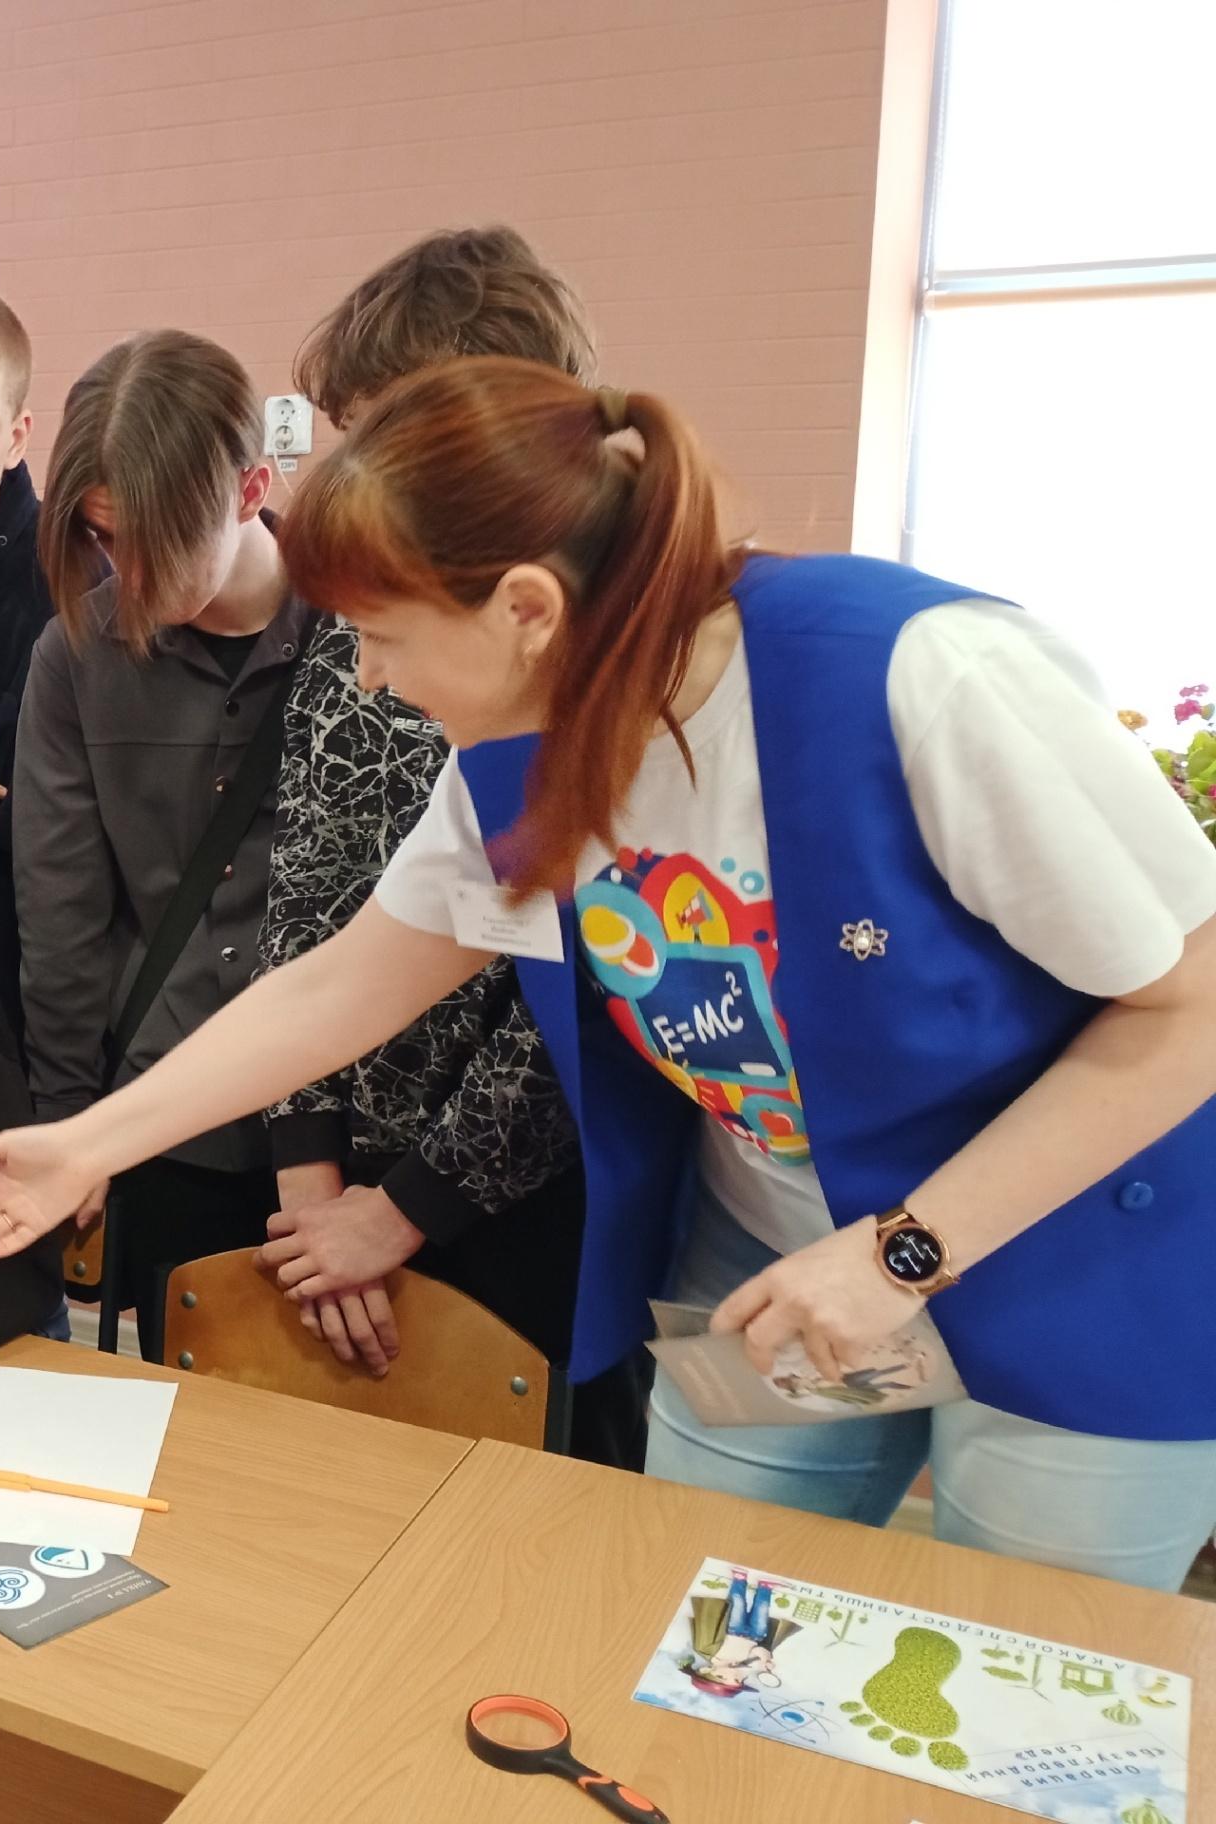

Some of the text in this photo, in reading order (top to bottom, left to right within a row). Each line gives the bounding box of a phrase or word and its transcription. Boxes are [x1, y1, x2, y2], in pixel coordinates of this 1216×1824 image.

[834, 1594, 950, 1628] ОСТАВИШЬ
[957, 1623, 1017, 1644] СЛЕД
[1025, 1639, 1104, 1666] КАКОЙ
[1114, 1662, 1126, 1670] А
[1020, 1764, 1141, 1788] Операция
